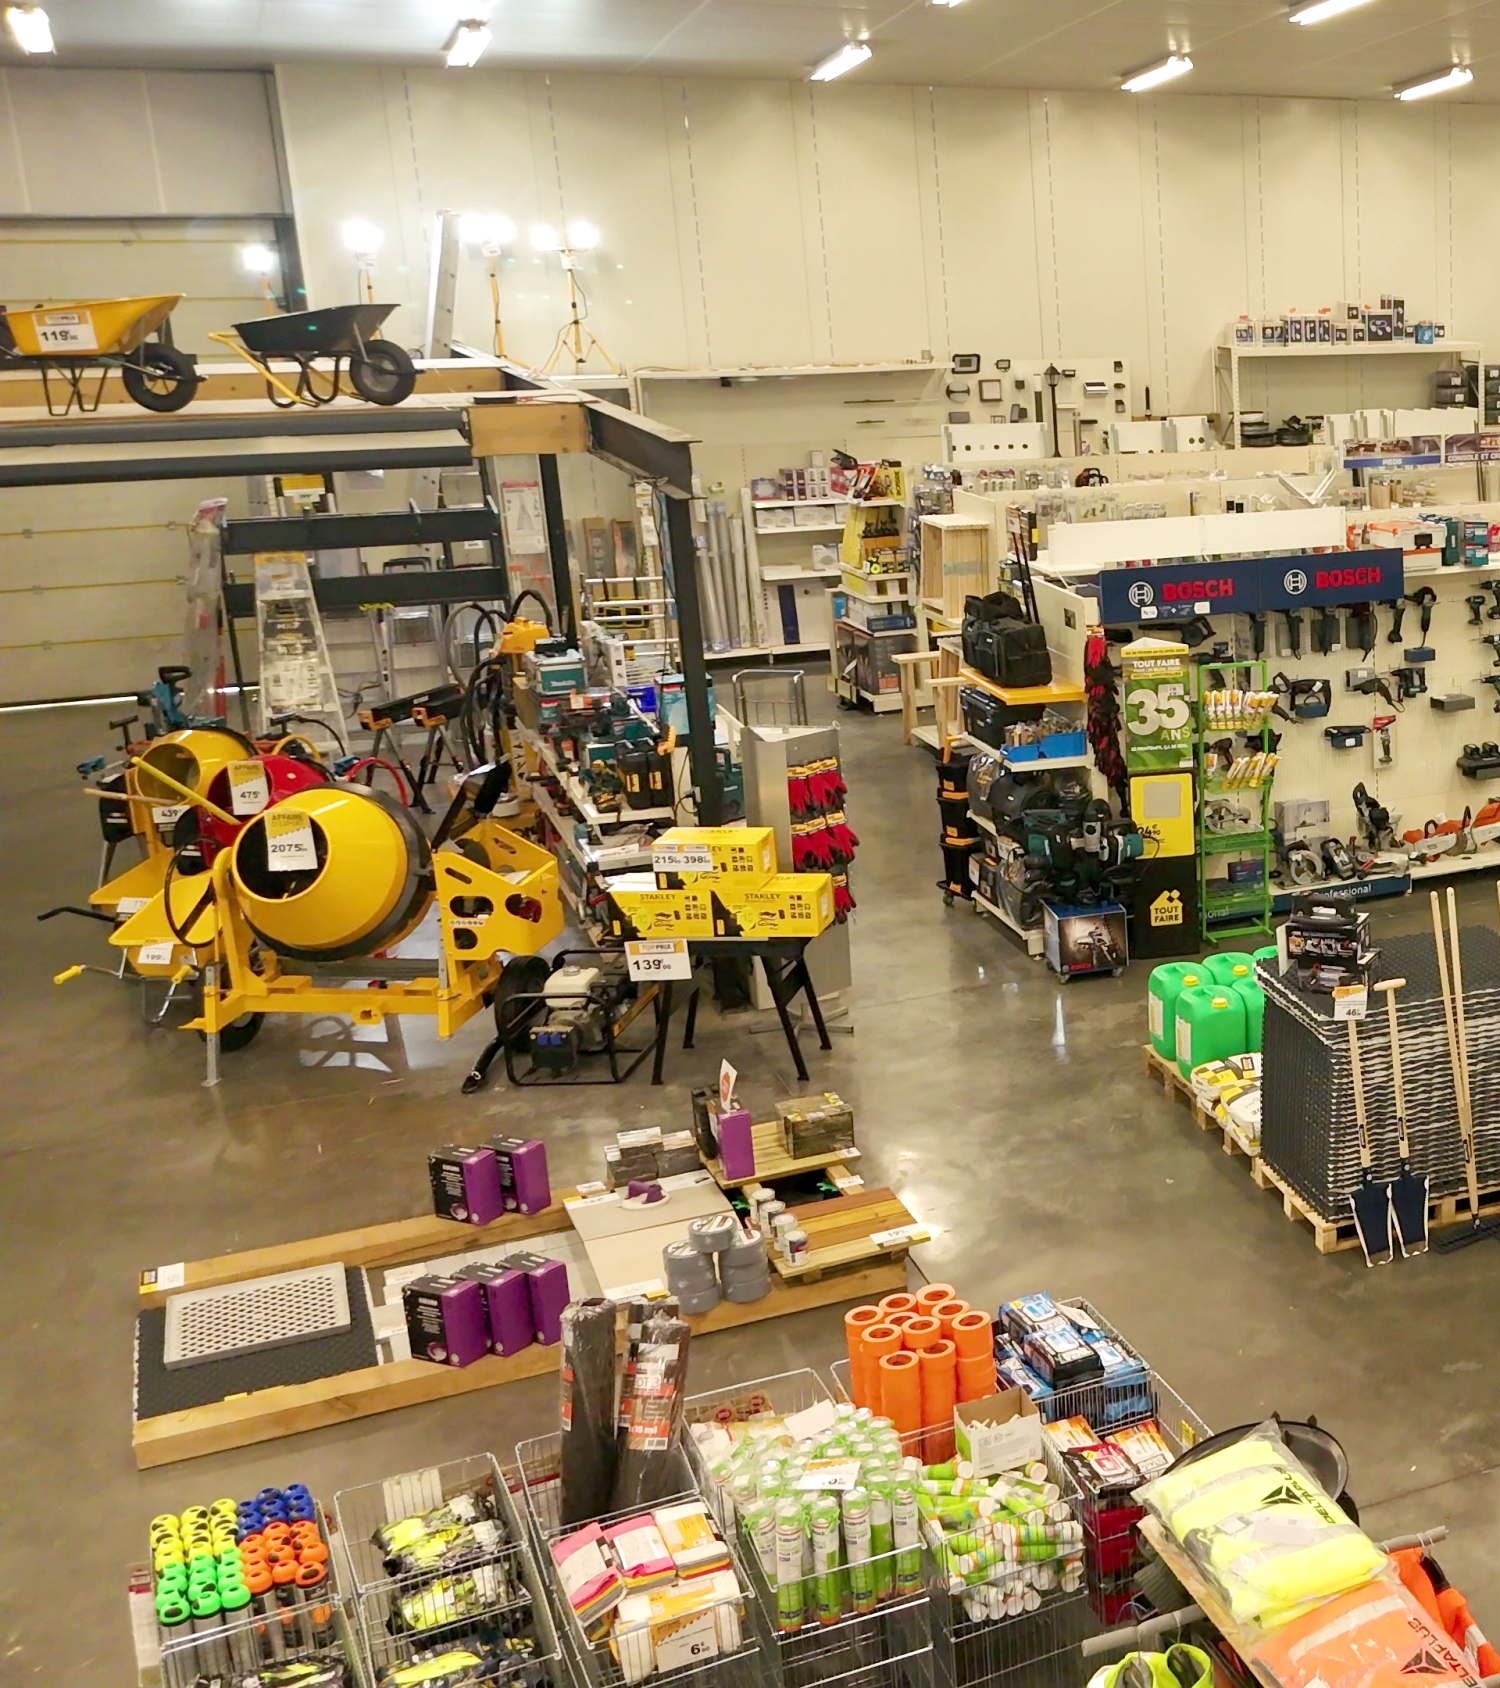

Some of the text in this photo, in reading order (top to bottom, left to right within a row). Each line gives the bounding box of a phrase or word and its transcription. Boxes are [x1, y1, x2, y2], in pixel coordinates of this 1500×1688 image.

[1315, 567, 1381, 588] BOSCH
[1162, 578, 1234, 602] BOSCH
[1132, 658, 1181, 668] TOUT FAIRE
[1127, 683, 1189, 736] 35
[1161, 726, 1191, 740] ANS
[1154, 906, 1179, 915] TOUT
[1154, 914, 1179, 923] FAIRE
[1274, 1466, 1337, 1525] DELTAPLUS
[1407, 1616, 1478, 1688] ELTAPLUS
